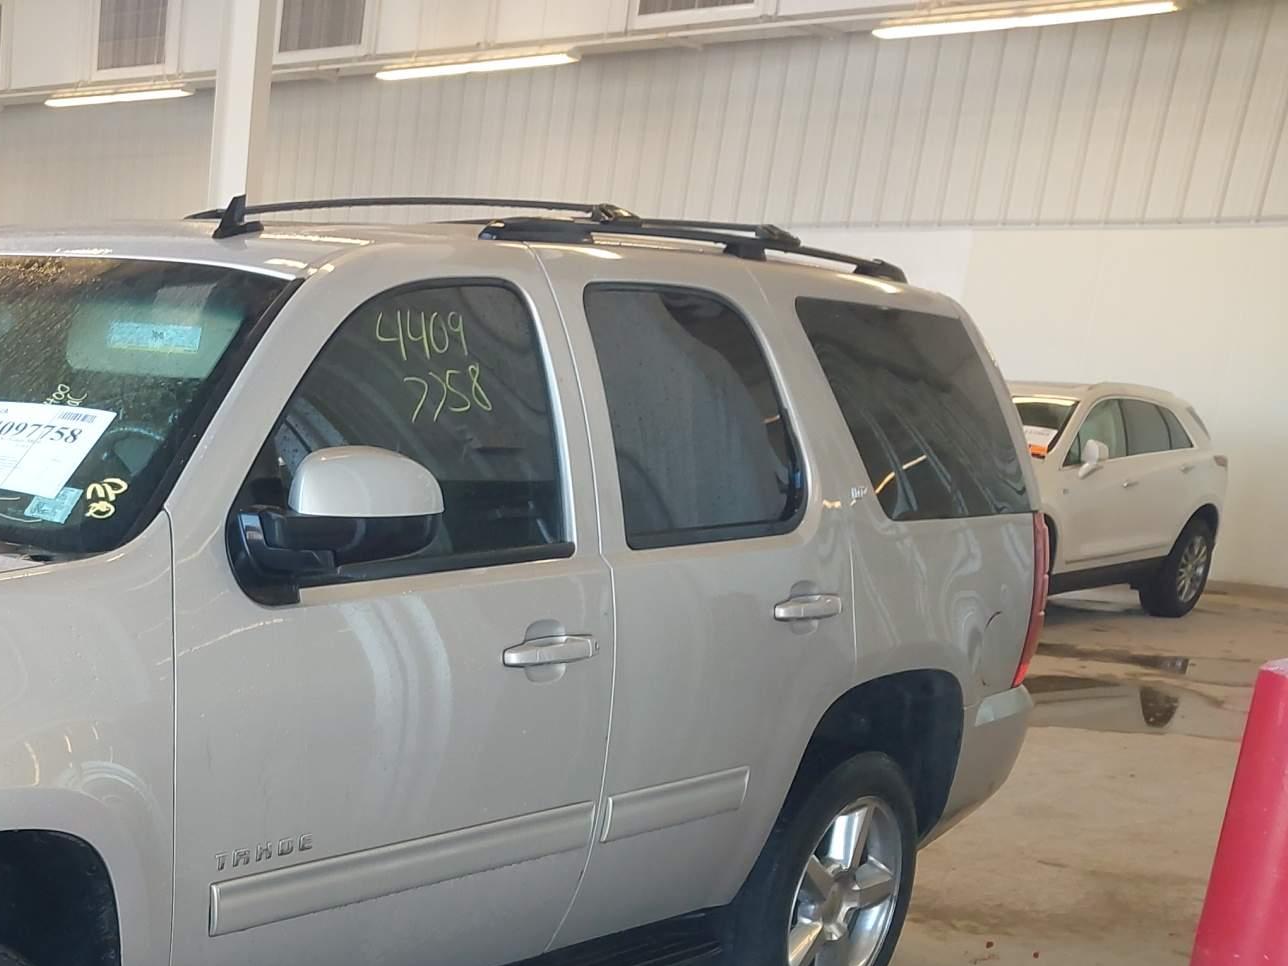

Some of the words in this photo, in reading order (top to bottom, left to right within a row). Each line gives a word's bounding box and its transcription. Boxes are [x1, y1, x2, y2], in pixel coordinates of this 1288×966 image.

[376, 309, 469, 361] 4409
[403, 361, 493, 423] 7758
[215, 833, 313, 871] TAHOE
